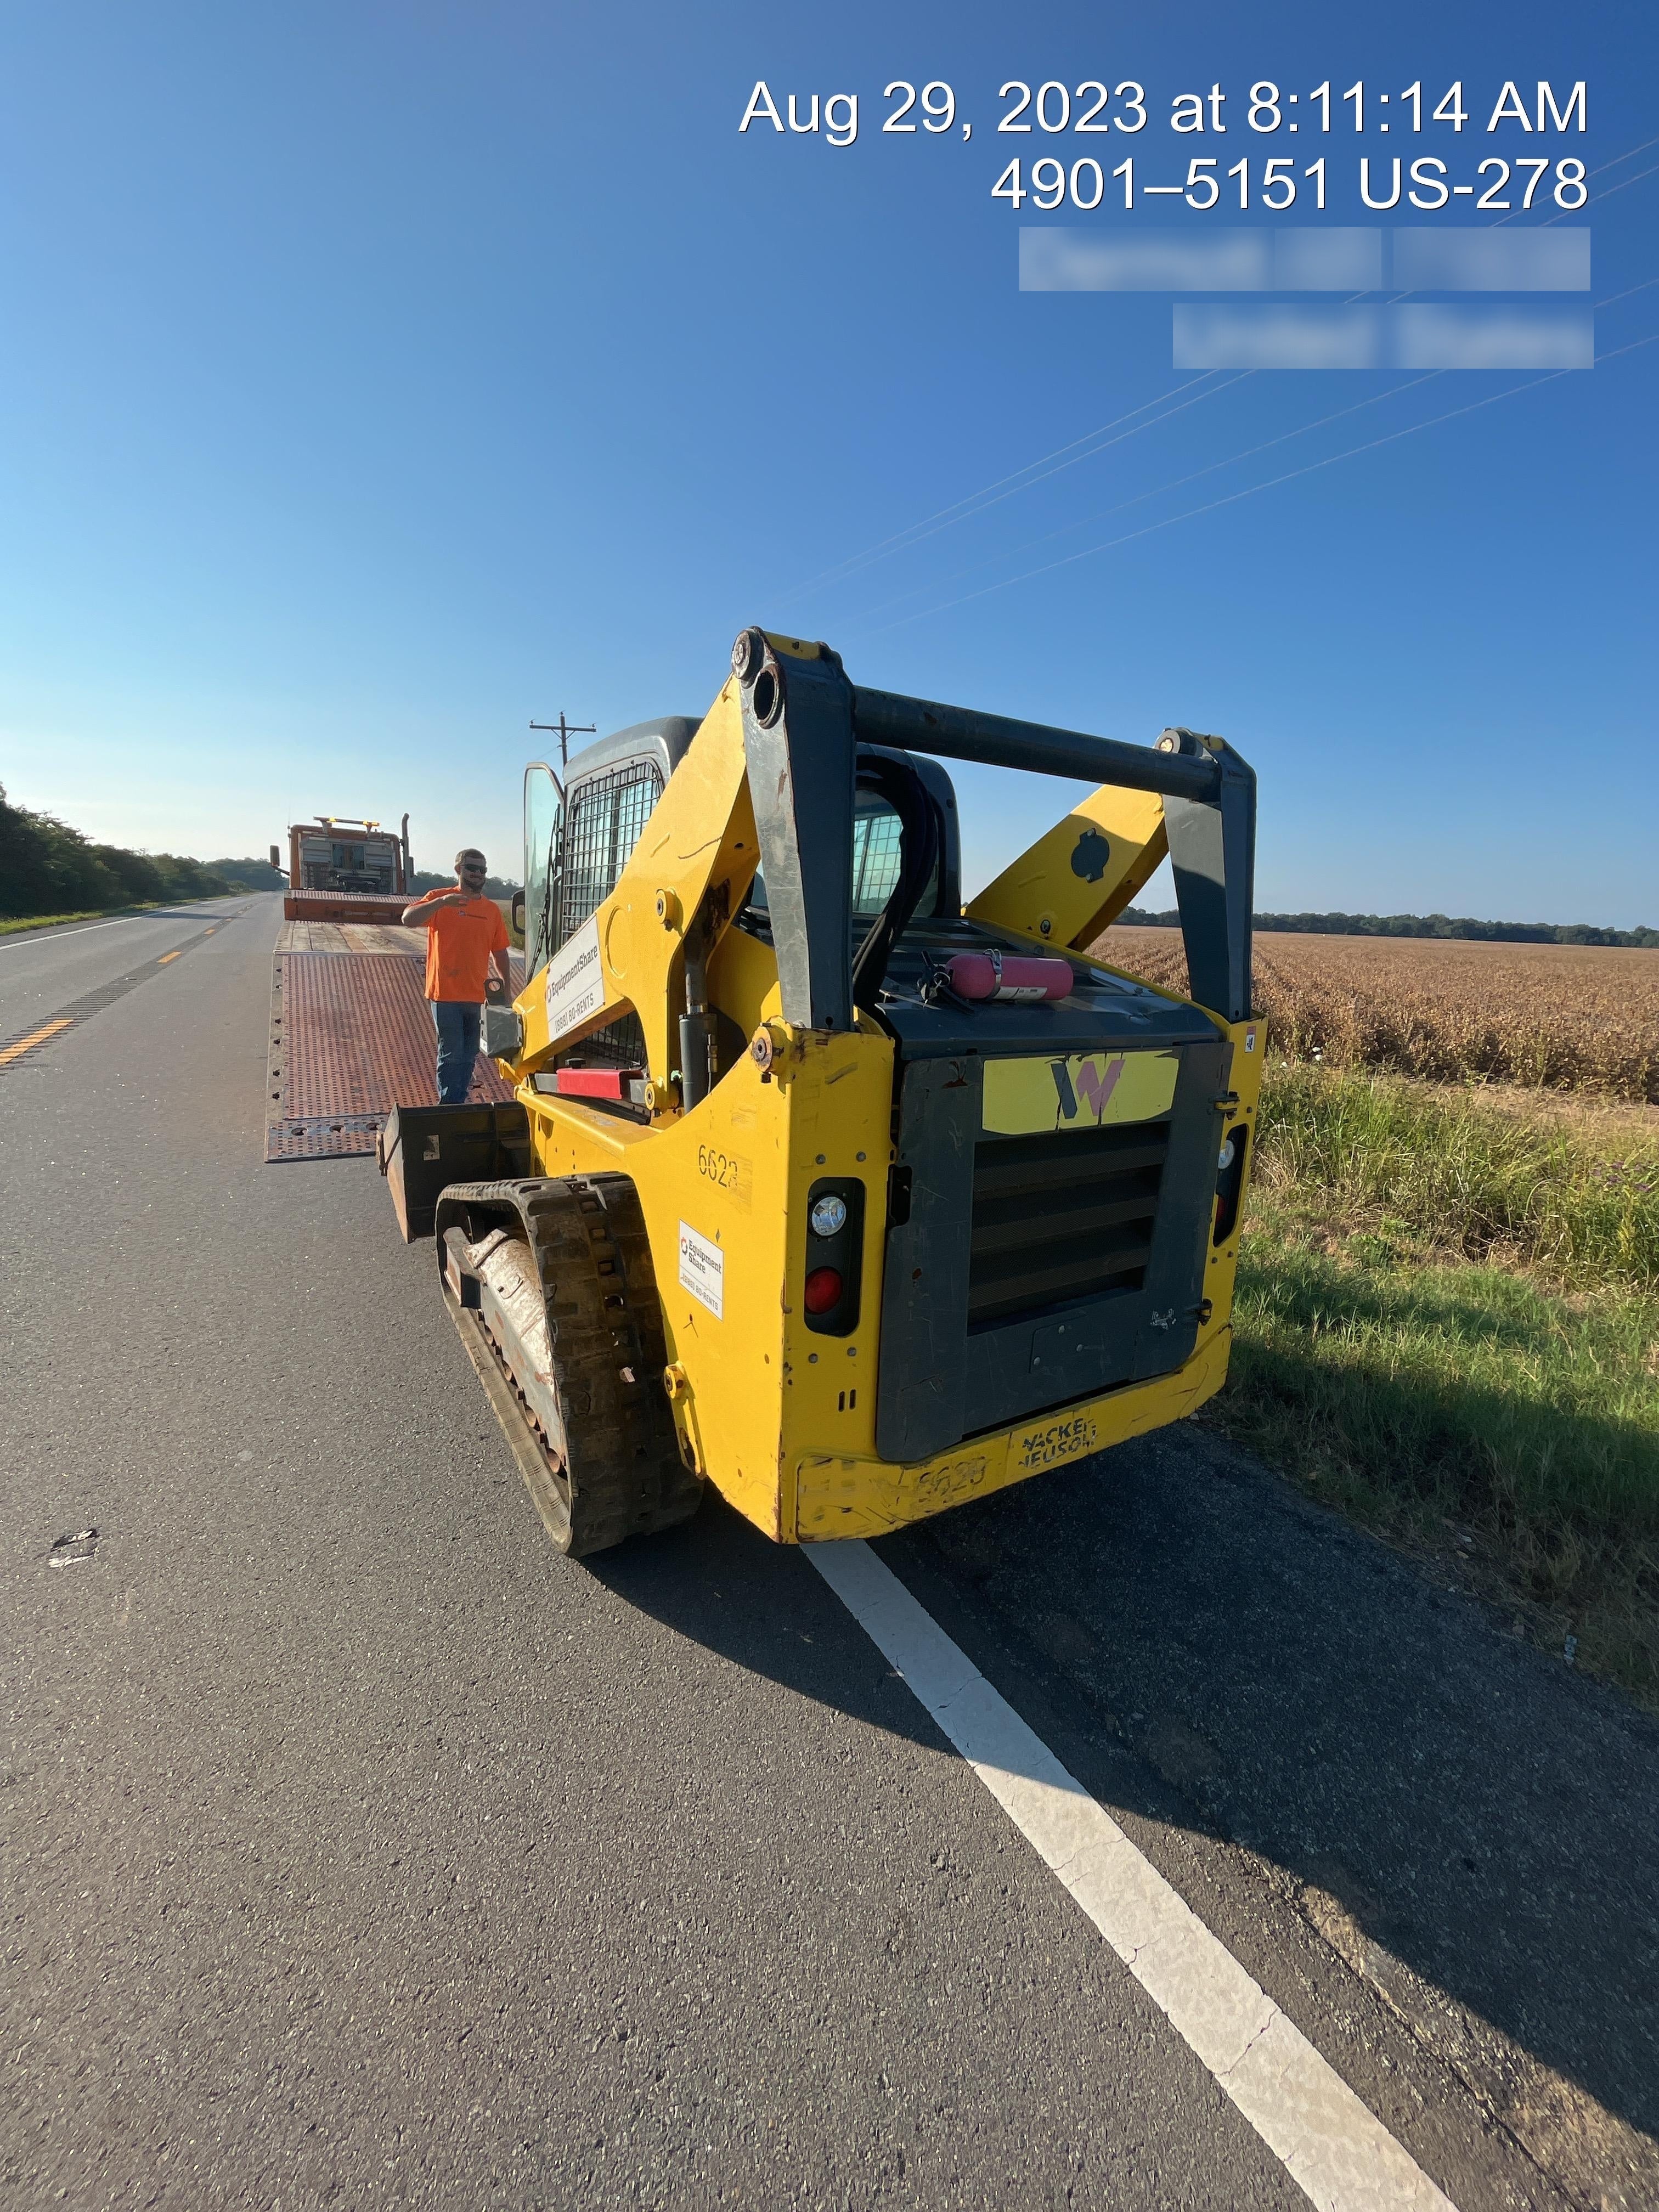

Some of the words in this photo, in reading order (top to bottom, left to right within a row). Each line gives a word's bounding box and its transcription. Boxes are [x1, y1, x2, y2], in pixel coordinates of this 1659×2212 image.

[552, 945, 598, 996] EquipmentShare
[555, 1012, 568, 1034] (888)
[689, 1239, 721, 1274] Equipment
[689, 1252, 706, 1274] Share
